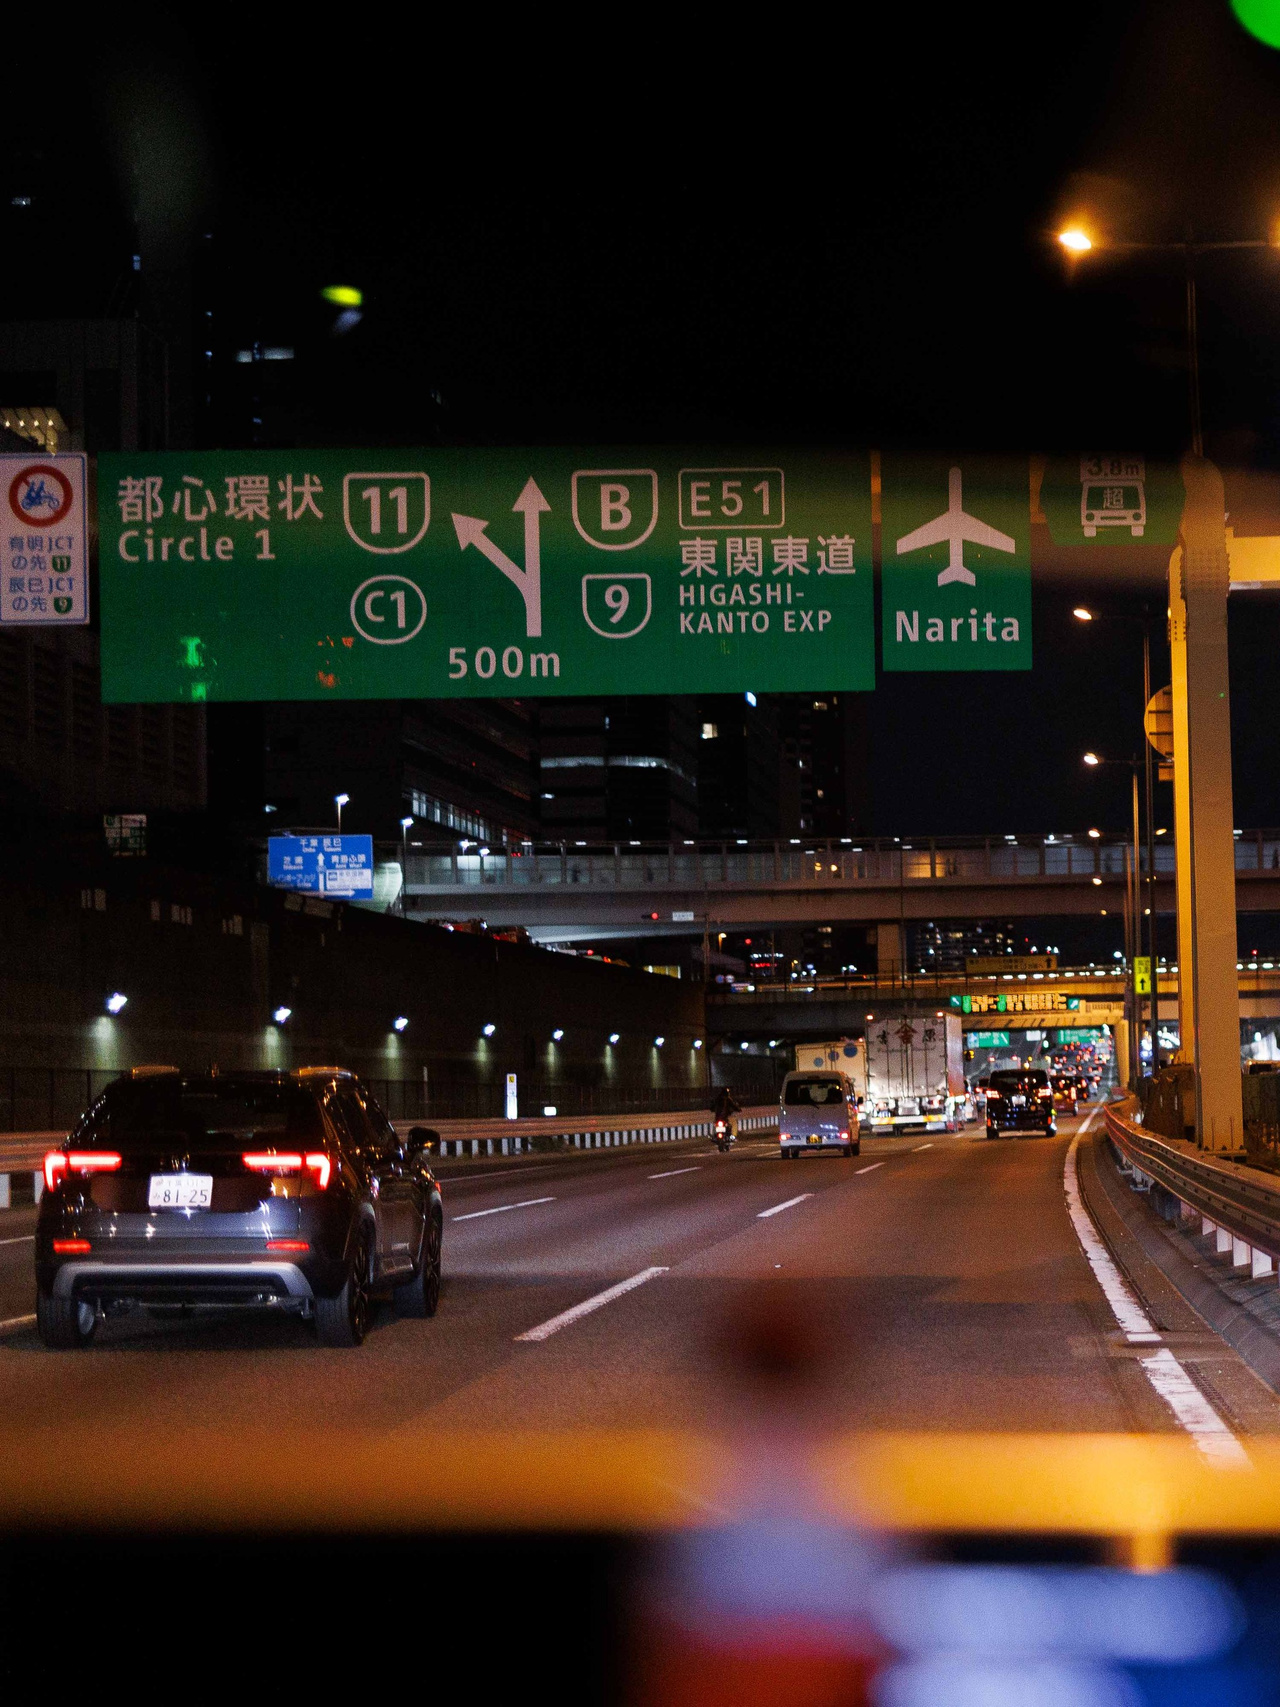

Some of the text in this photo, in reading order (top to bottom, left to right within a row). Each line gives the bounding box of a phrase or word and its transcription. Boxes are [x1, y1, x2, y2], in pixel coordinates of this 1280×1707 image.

[118, 473, 324, 524] 都心環状
[361, 486, 409, 534] 11
[600, 483, 633, 531] B
[690, 480, 771, 517] E51
[118, 527, 277, 563] Circle 1
[679, 534, 856, 577] 東関東道
[363, 589, 407, 629] C1
[604, 583, 630, 624] 9
[679, 583, 805, 606] HIGASHI-
[679, 610, 832, 634] KANTO EXP
[896, 608, 1020, 642] Narita
[448, 646, 561, 679] 500m
[163, 1189, 208, 1203] 81-25
